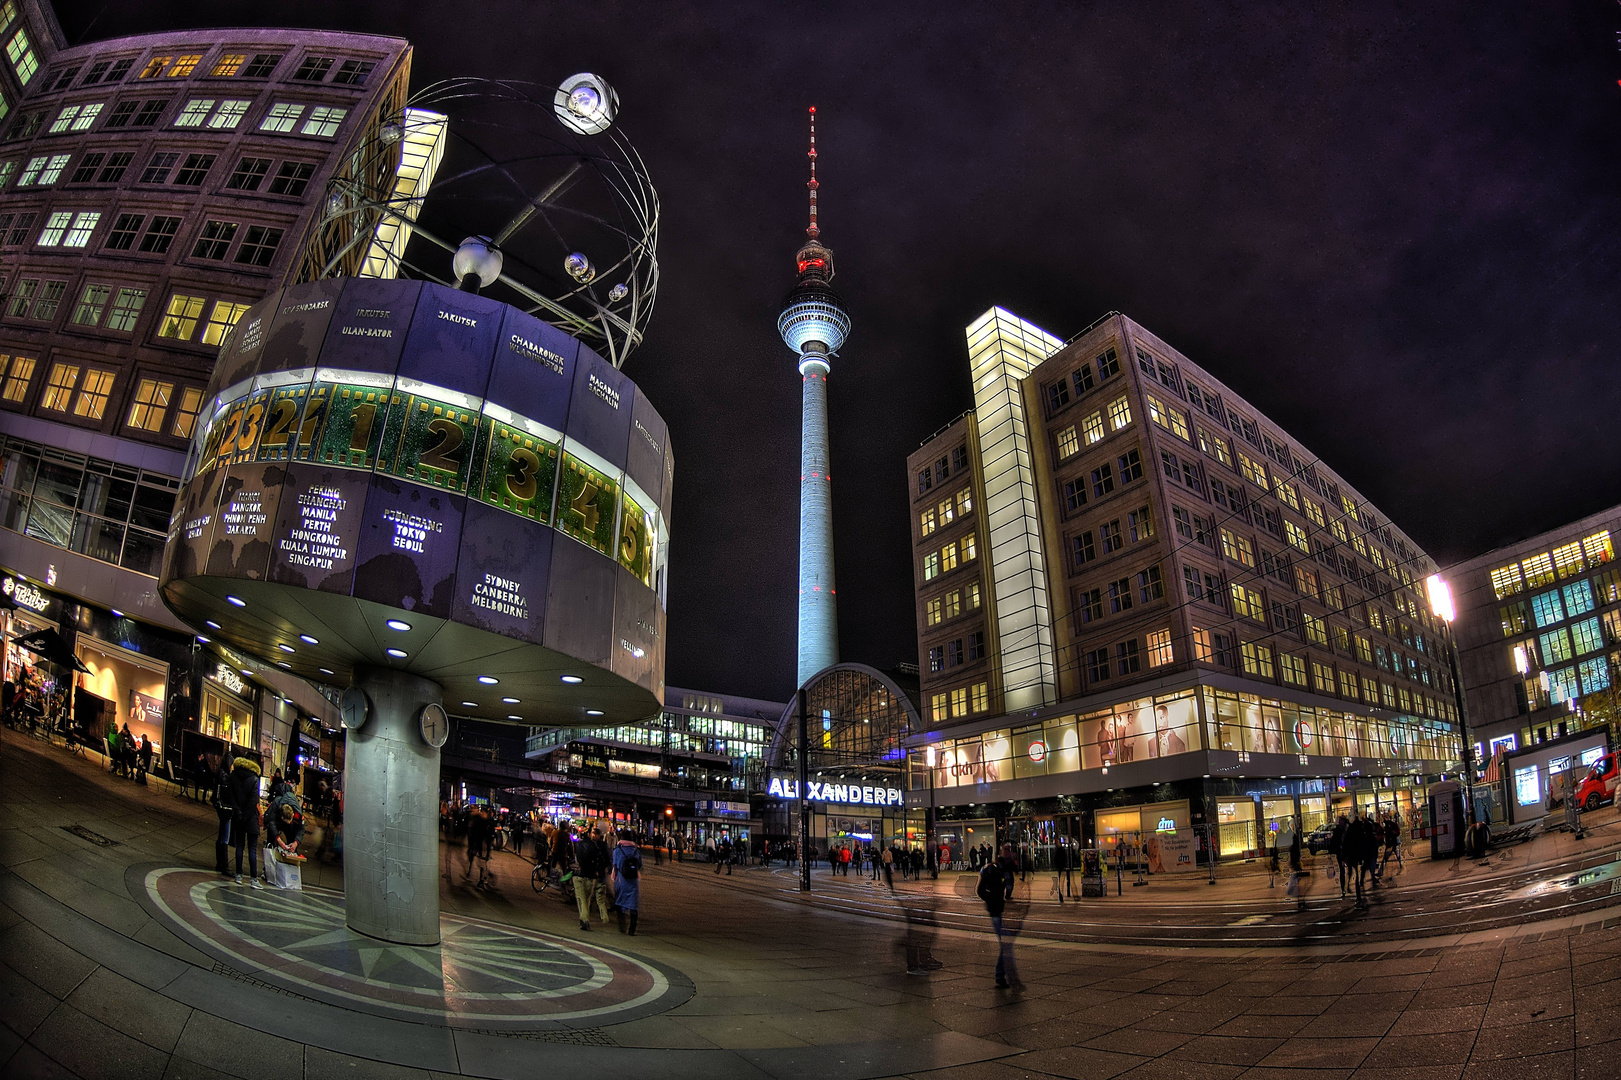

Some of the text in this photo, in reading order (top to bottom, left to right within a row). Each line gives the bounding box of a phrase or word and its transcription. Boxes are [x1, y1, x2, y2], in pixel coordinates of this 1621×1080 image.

[438, 310, 477, 328] JAKUTSK
[511, 334, 564, 366] CHABAROWSK
[588, 383, 619, 410] SACHALIN
[589, 374, 619, 401] MAGADAN
[219, 403, 264, 456] 23
[261, 398, 324, 446] 24
[349, 403, 377, 452] 1
[419, 418, 464, 474] 2
[505, 447, 540, 500] 3
[308, 484, 340, 498] PEKING
[231, 503, 262, 513] BANGKOK
[298, 494, 347, 510] SHANGHAI
[571, 481, 600, 533] 4
[247, 514, 266, 524] PENH
[302, 507, 337, 521] MANILA
[303, 518, 332, 532] PERTH
[396, 524, 426, 541] TOKYO
[291, 529, 340, 546] HONGKONG
[393, 536, 425, 553] SEOUL
[622, 512, 638, 562] 5
[280, 539, 347, 560] KUALA LUMPUR
[288, 553, 333, 570] SINGAPUR
[485, 573, 520, 593] SYDNEY
[475, 583, 527, 607] CANBERRA
[471, 594, 528, 619] MELBOURNE
[1157, 817, 1175, 829] dm
[1178, 853, 1190, 862] dm
